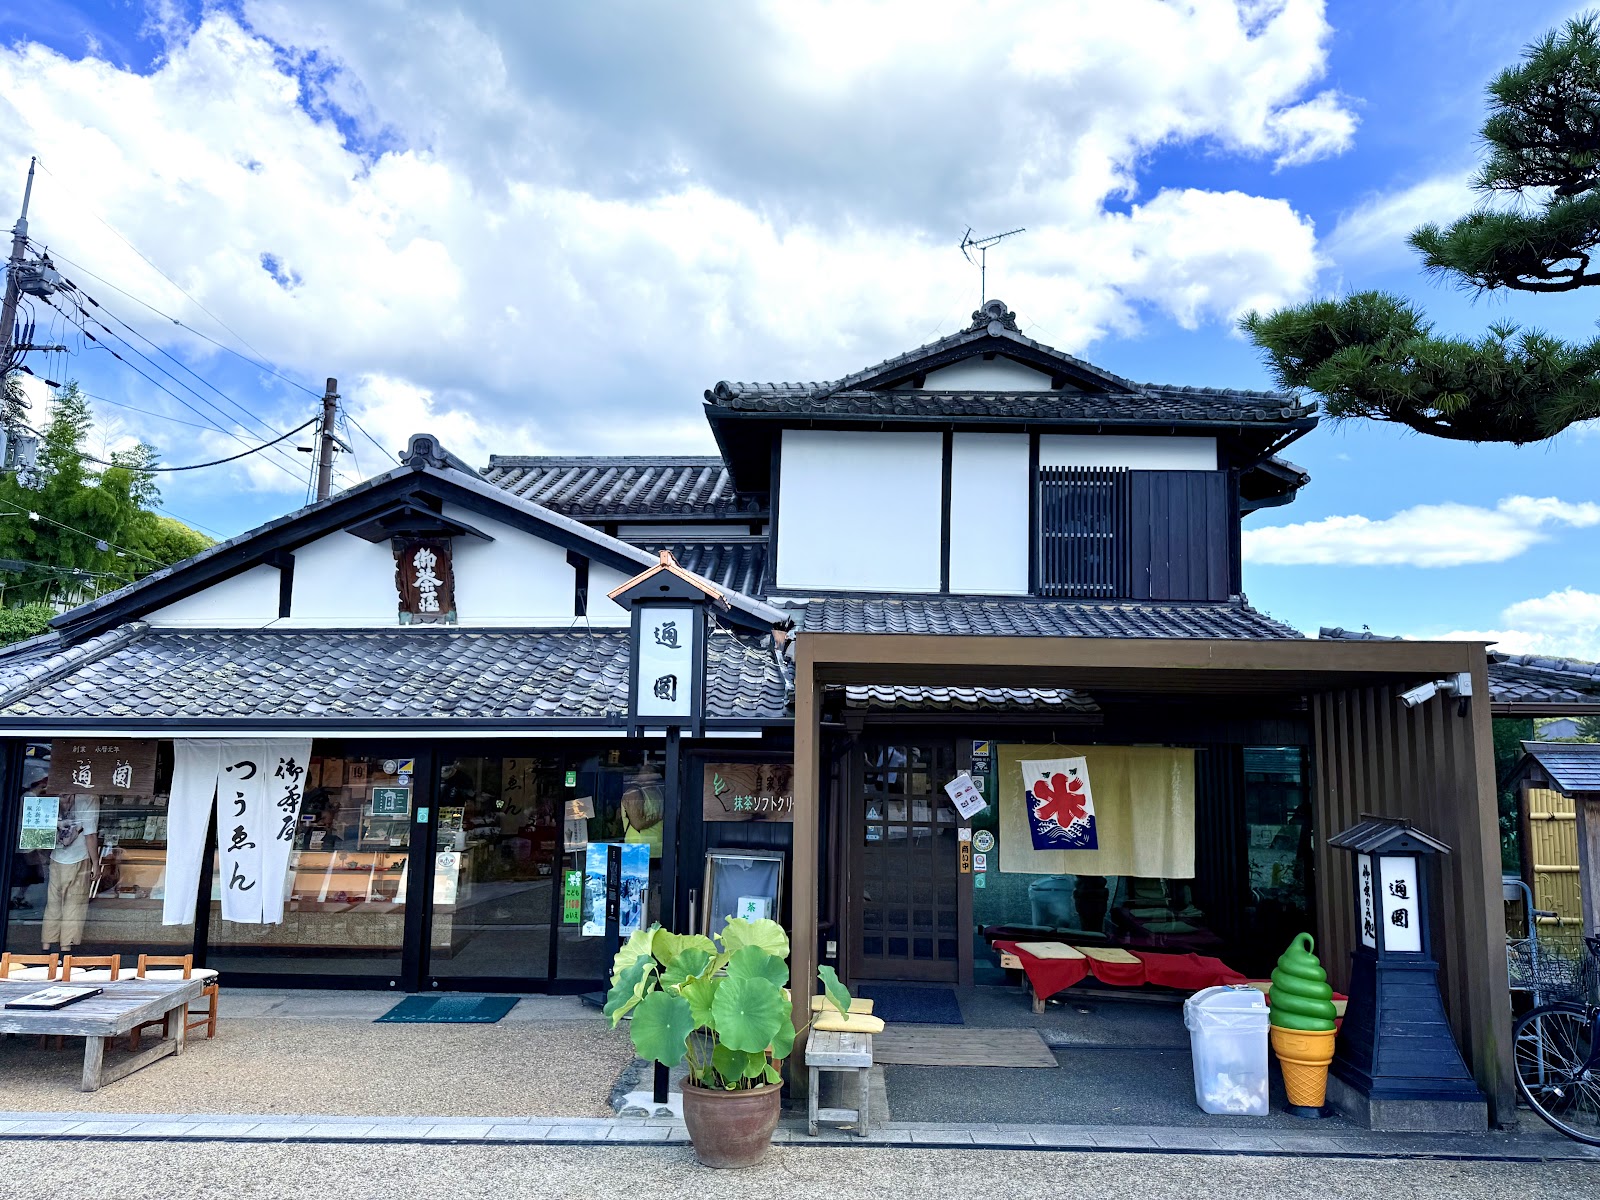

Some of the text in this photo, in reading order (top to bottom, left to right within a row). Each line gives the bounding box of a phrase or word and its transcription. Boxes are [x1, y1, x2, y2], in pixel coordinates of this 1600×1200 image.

[72, 745, 87, 753] 創業
[734, 795, 794, 812] 抹茶ソフトクリ
[1034, 773, 1087, 828] 氷
